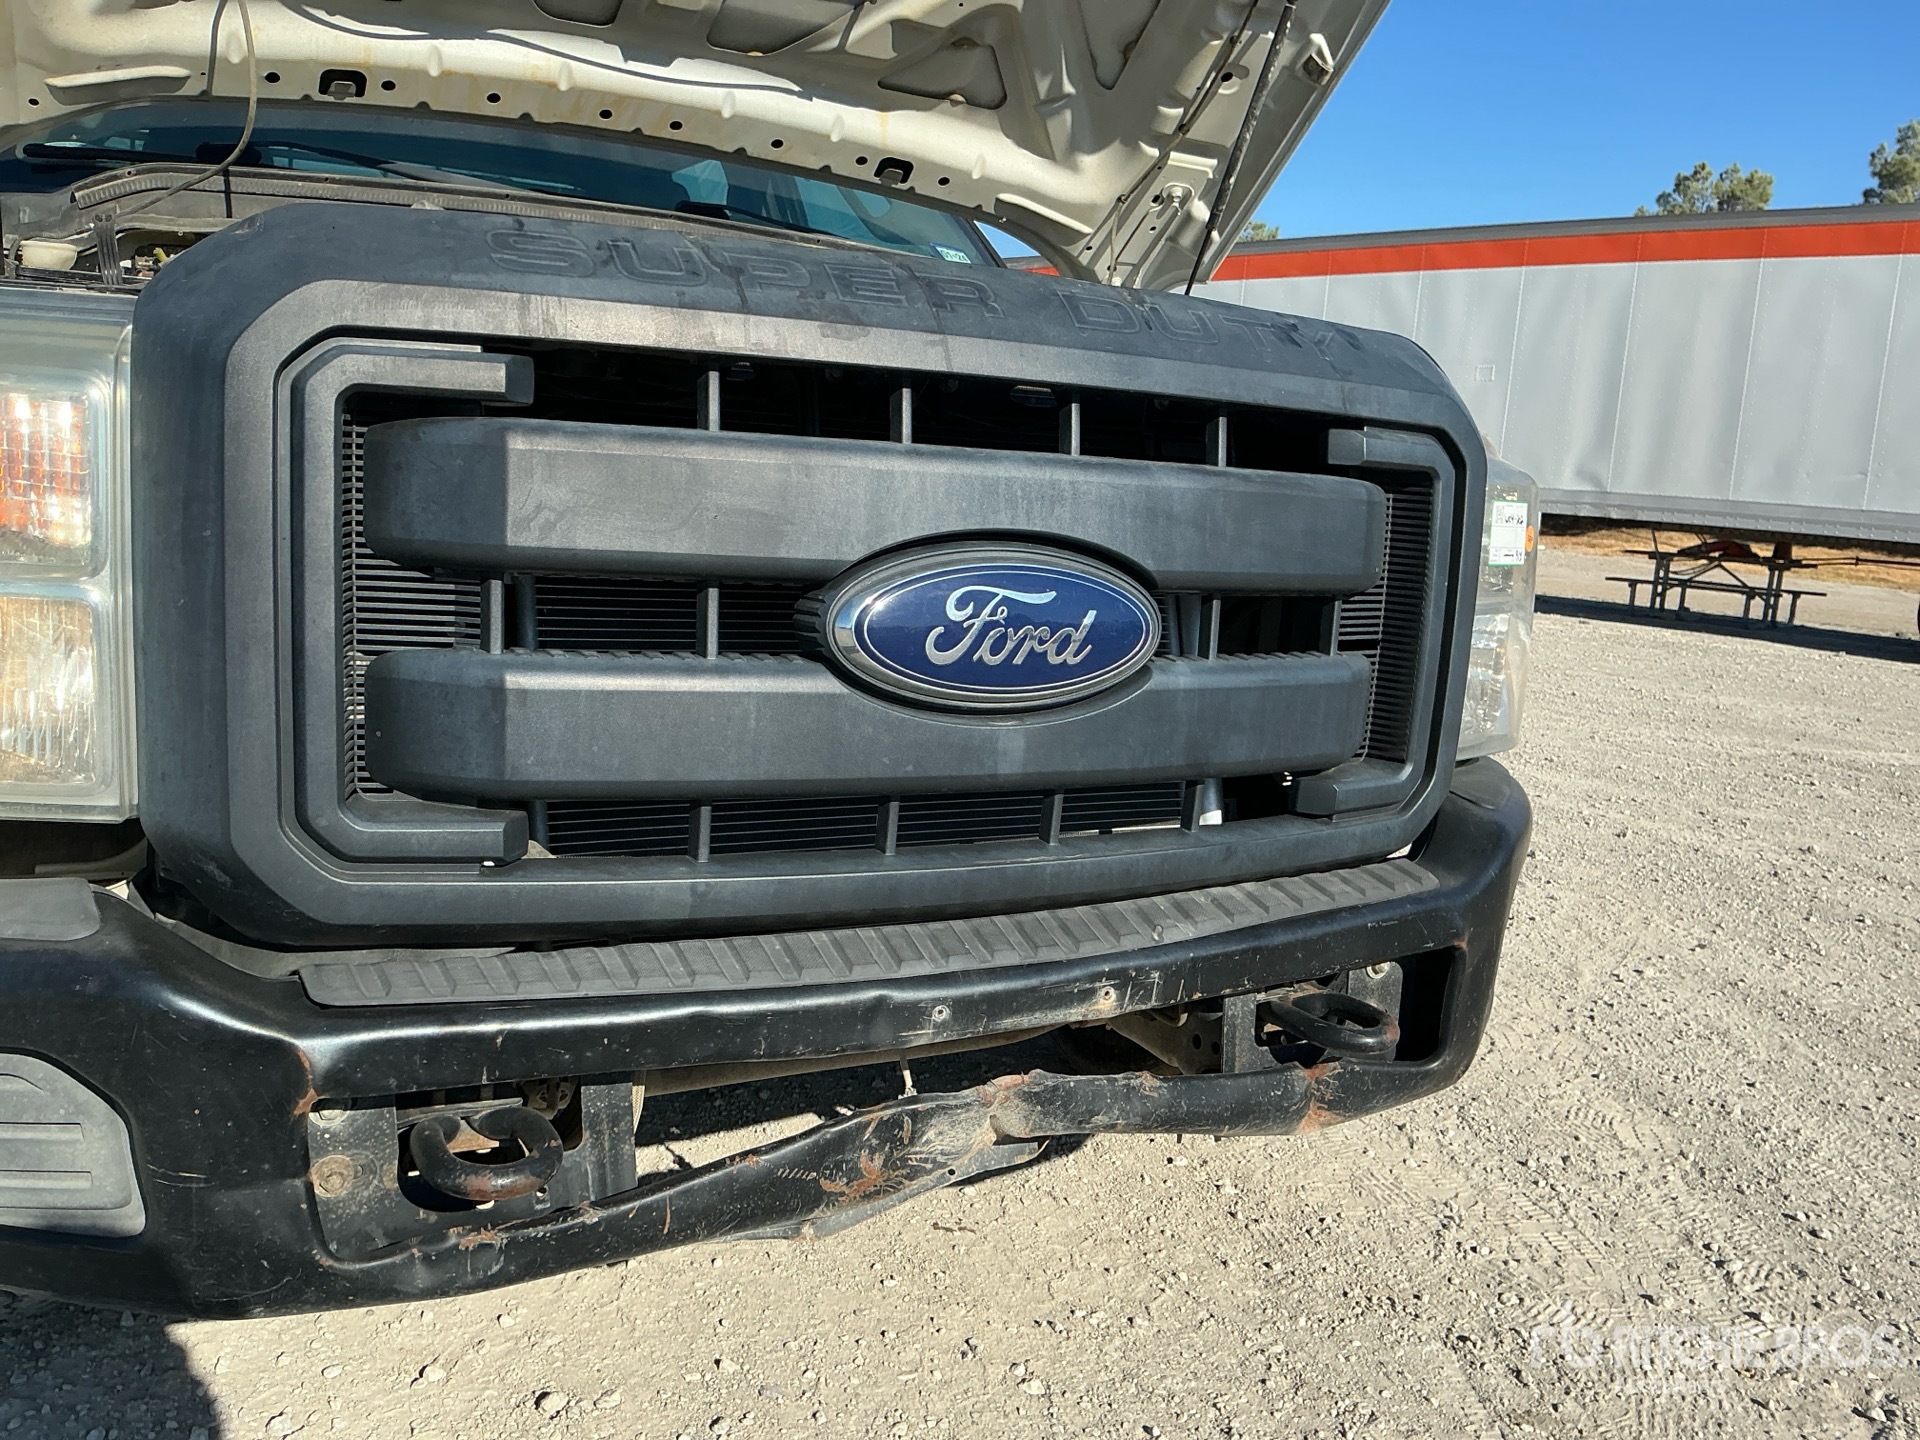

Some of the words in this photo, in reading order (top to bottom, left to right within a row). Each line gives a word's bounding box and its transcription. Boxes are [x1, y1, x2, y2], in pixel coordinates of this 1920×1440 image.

[485, 229, 1005, 319] SUPER
[1056, 288, 1335, 361] DUTY
[925, 585, 1098, 667] Ford
